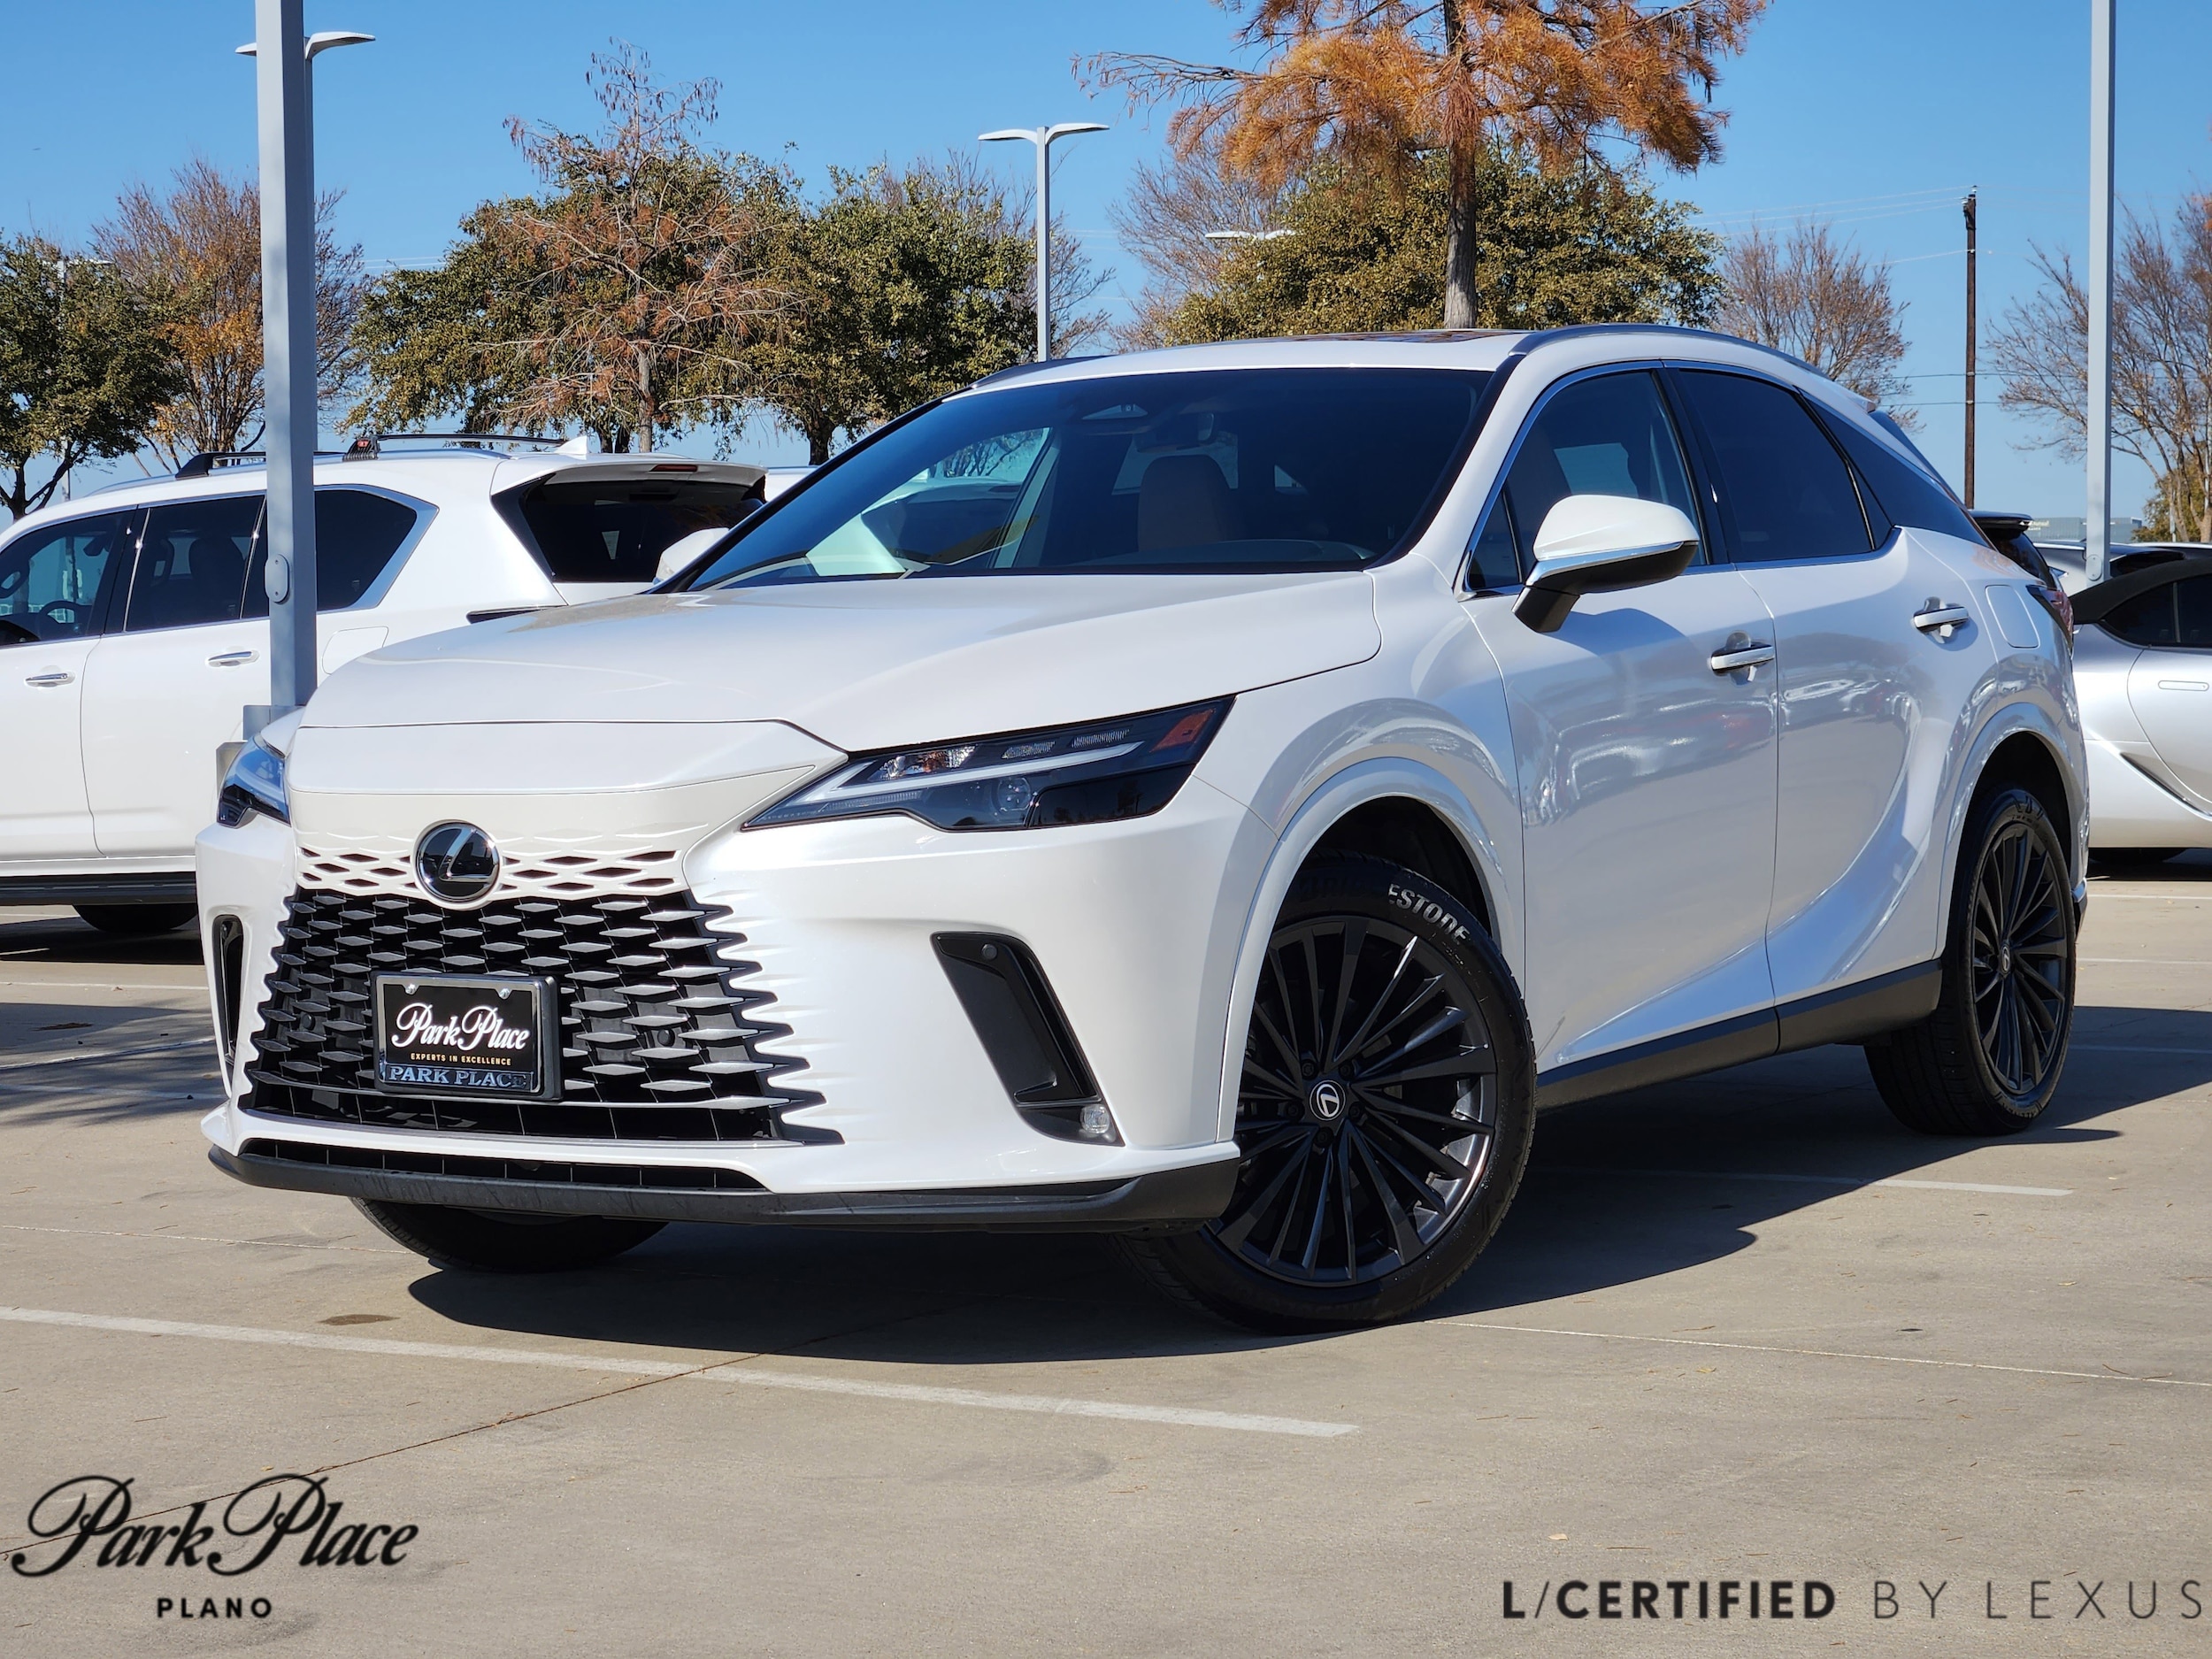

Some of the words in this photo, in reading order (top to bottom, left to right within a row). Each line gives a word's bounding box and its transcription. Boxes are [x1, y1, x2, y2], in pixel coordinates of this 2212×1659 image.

[391, 1002, 461, 1048] Park
[457, 1005, 530, 1050] Place
[411, 1053, 446, 1062] EXPERTS
[461, 1056, 511, 1066] EXCELLENCE
[389, 1065, 449, 1084] PARK
[454, 1070, 527, 1089] PLACE
